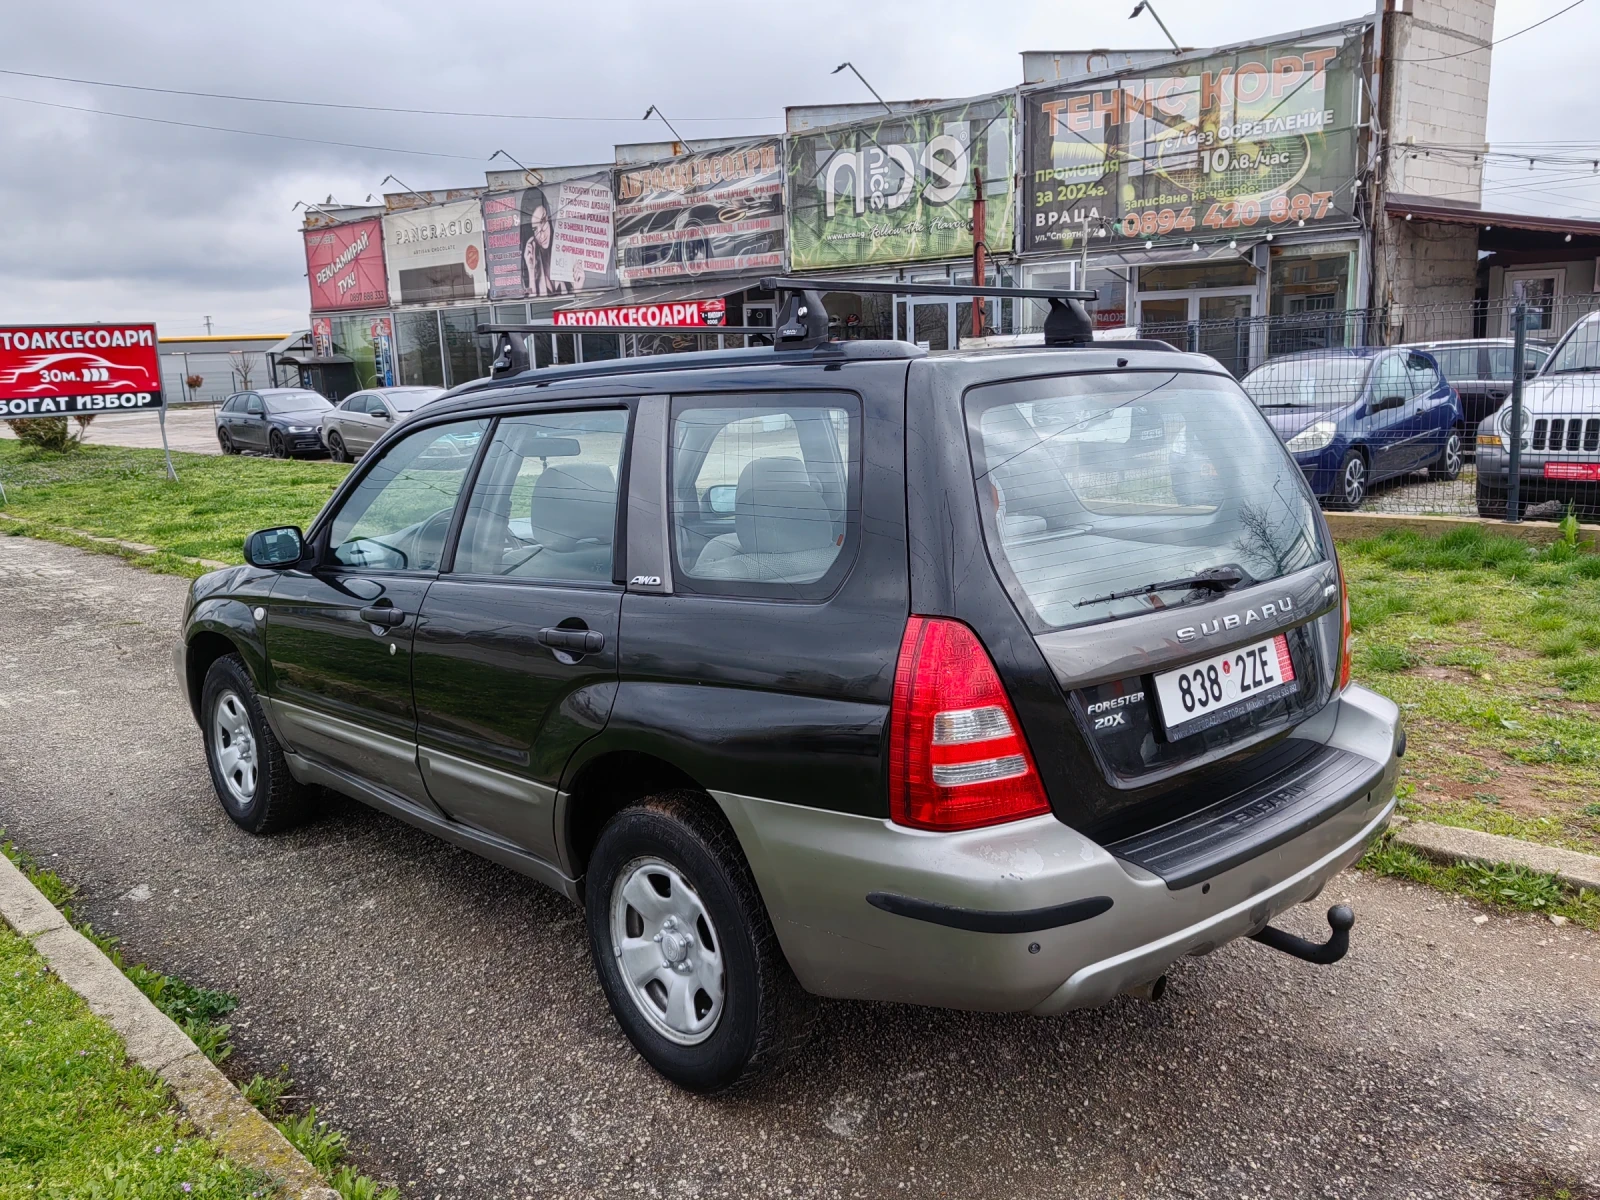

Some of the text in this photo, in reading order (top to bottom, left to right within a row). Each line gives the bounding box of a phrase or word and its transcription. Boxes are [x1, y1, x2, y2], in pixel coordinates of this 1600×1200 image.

[1042, 47, 1337, 136] ТЕНИС КОРТ
[1217, 109, 1334, 140] ОСВЕТЛЕНИЕ
[618, 145, 778, 200] АВТОАКСЕСОАРИ
[1035, 159, 1119, 182] ПРОМОЦИЯ
[1035, 182, 1108, 207] за 2024г.
[1192, 191, 1207, 200] на
[1122, 190, 1334, 238] 0894 420 887
[396, 218, 473, 245] PANCRACIO
[826, 229, 865, 242] www.nice.bg
[904, 218, 924, 234] the
[316, 229, 370, 287] РЕКЛАМИРАЙ
[337, 271, 357, 296] ТУК!
[557, 303, 699, 327] АВТОАКСЕСОАРИ
[0, 329, 153, 351] ТОАКСЕСОАРИ
[77, 392, 152, 410] ИЗБОР
[630, 575, 661, 585] AWD
[1176, 596, 1293, 644] SUBARU
[1178, 664, 1223, 713] 838
[1235, 645, 1275, 693] 2ZE
[1087, 691, 1145, 715] FORESTER
